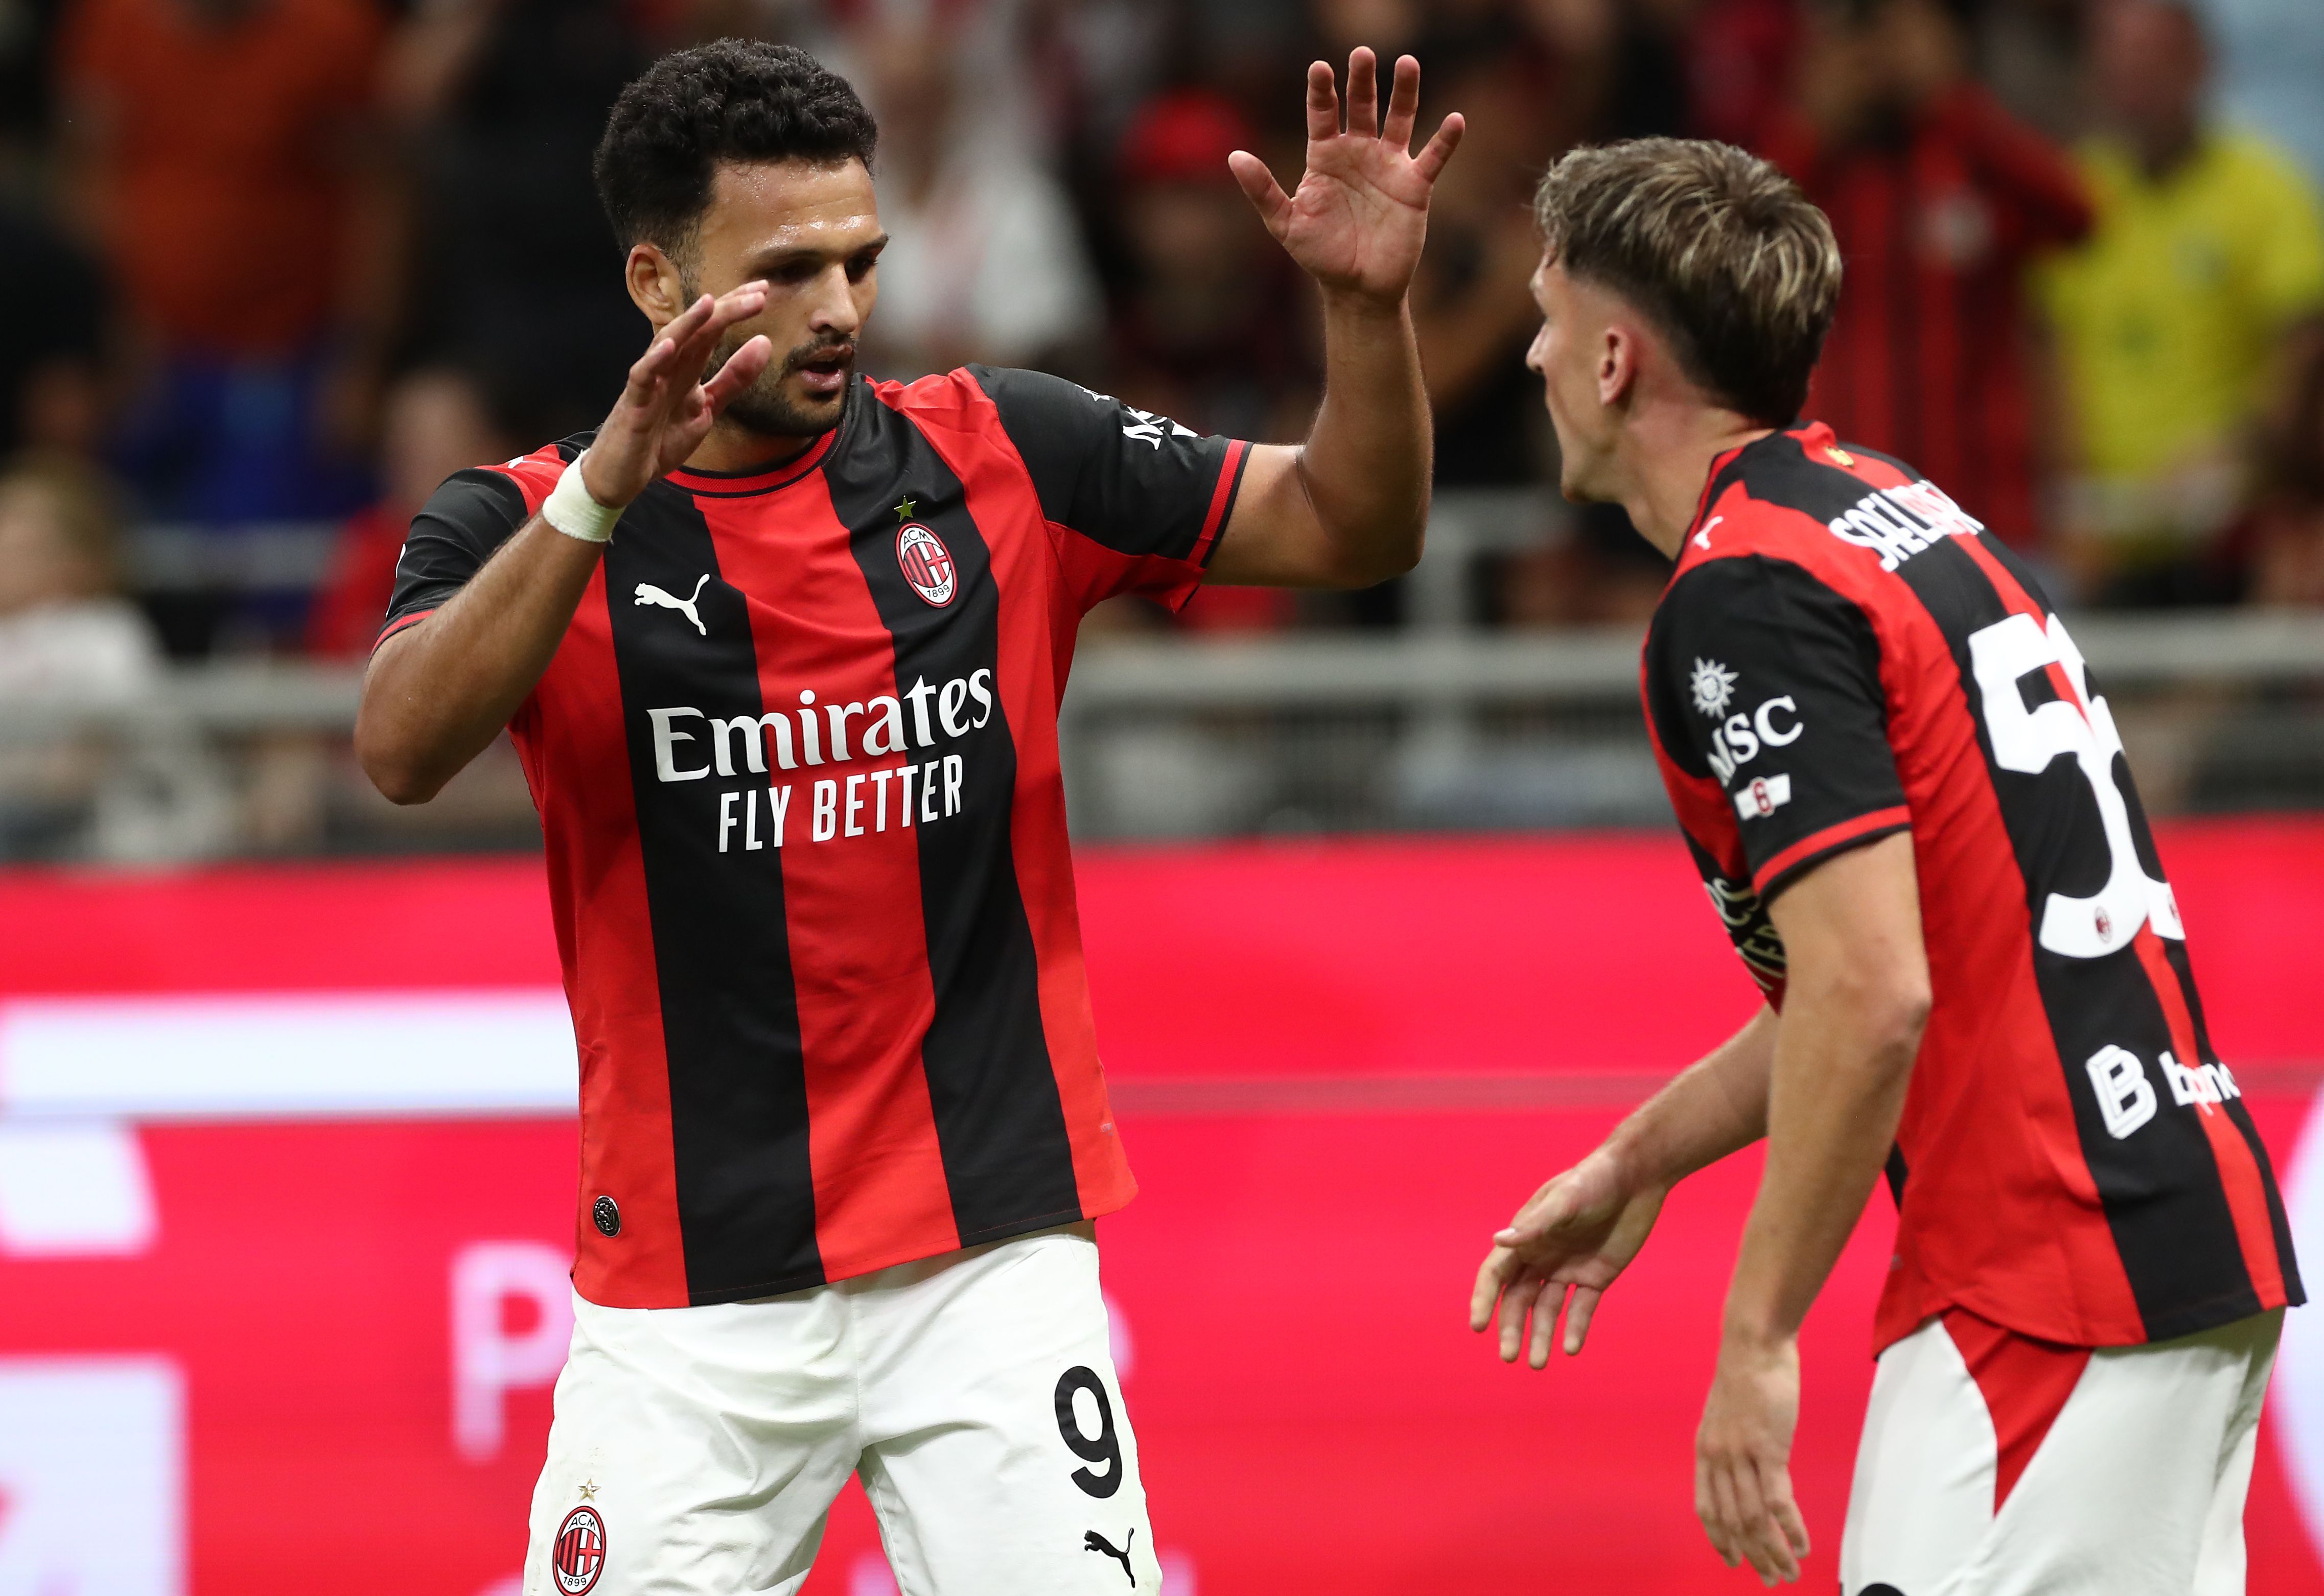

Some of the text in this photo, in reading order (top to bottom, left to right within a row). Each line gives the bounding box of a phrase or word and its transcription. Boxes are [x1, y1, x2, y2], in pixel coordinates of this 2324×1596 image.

[904, 530, 931, 549] ACM
[927, 584, 950, 597] 1899
[646, 668, 991, 782] Emirates
[1706, 695, 1804, 788] MSC
[719, 754, 963, 853] FLY BETTER
[1054, 1366, 1122, 1499] 9
[568, 1514, 596, 1531] ACM
[563, 1576, 587, 1587] 1899
